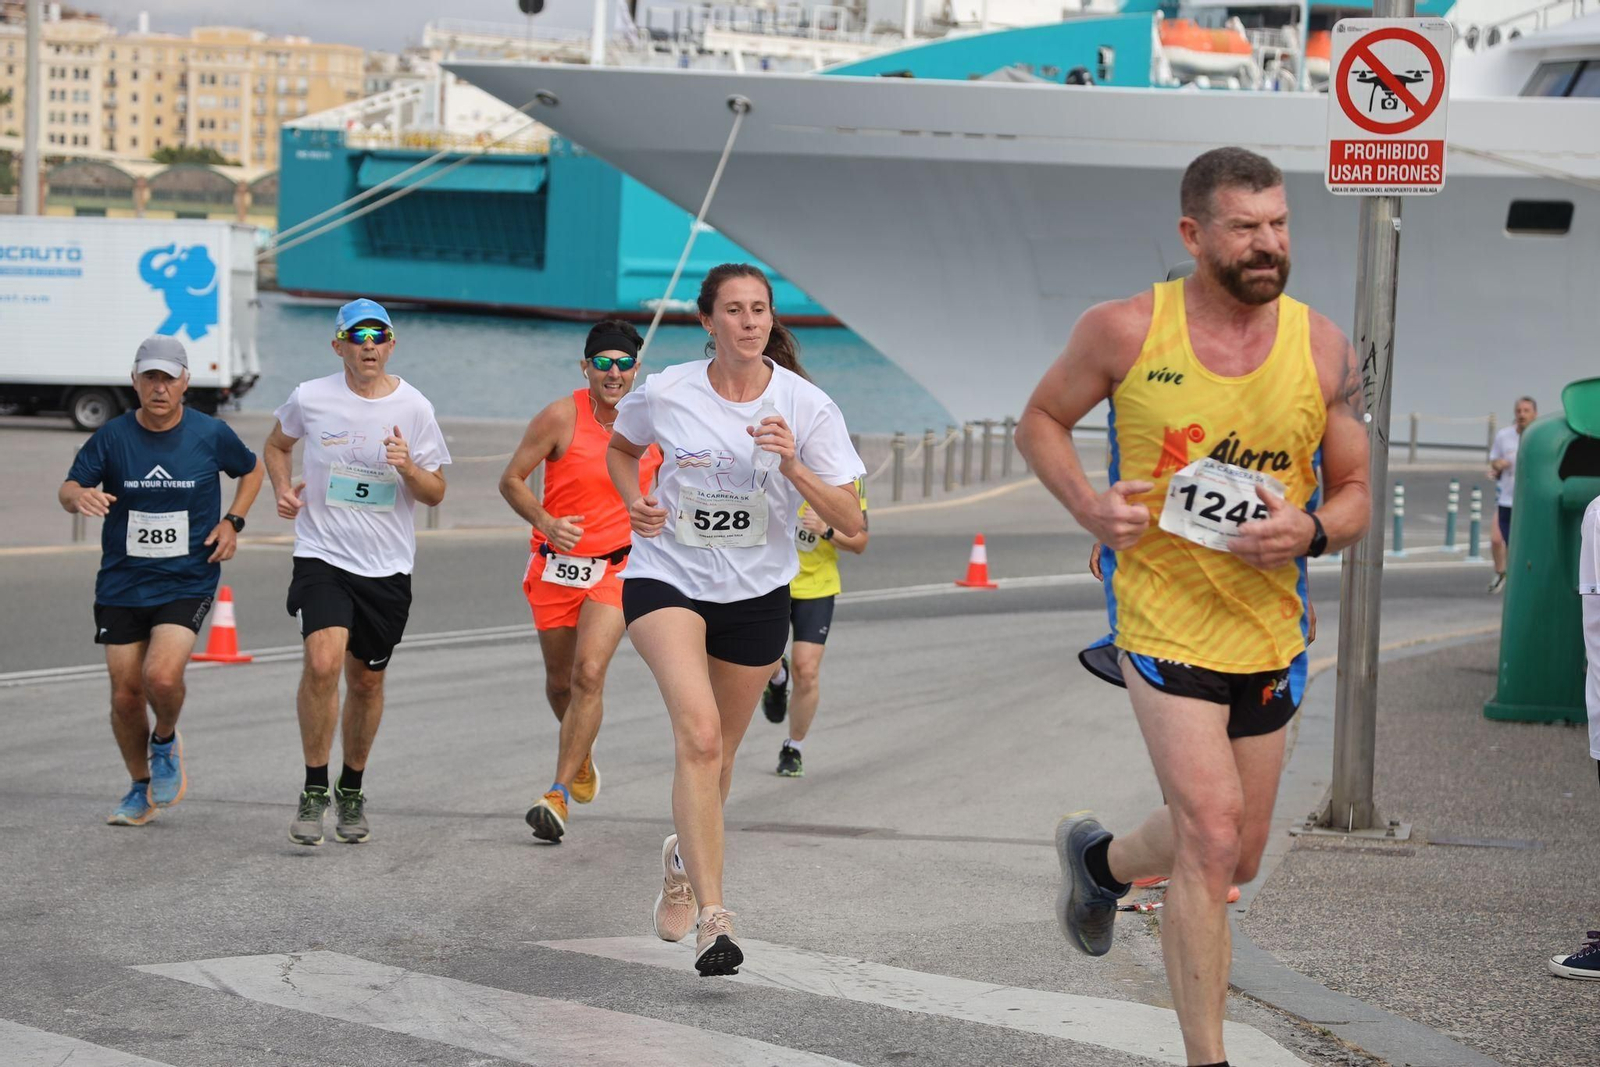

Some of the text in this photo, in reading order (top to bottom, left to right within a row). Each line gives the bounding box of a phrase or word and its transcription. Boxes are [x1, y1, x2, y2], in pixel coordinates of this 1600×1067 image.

[1344, 143, 1429, 160] PROHIBIDO
[1331, 164, 1440, 181] USAR DRONES
[1207, 431, 1291, 471] Álora
[124, 480, 195, 488] FIND YOUR EVEREST
[355, 483, 369, 498] 5
[694, 509, 750, 530] 528
[138, 528, 177, 544] 288
[555, 563, 592, 581] 593
